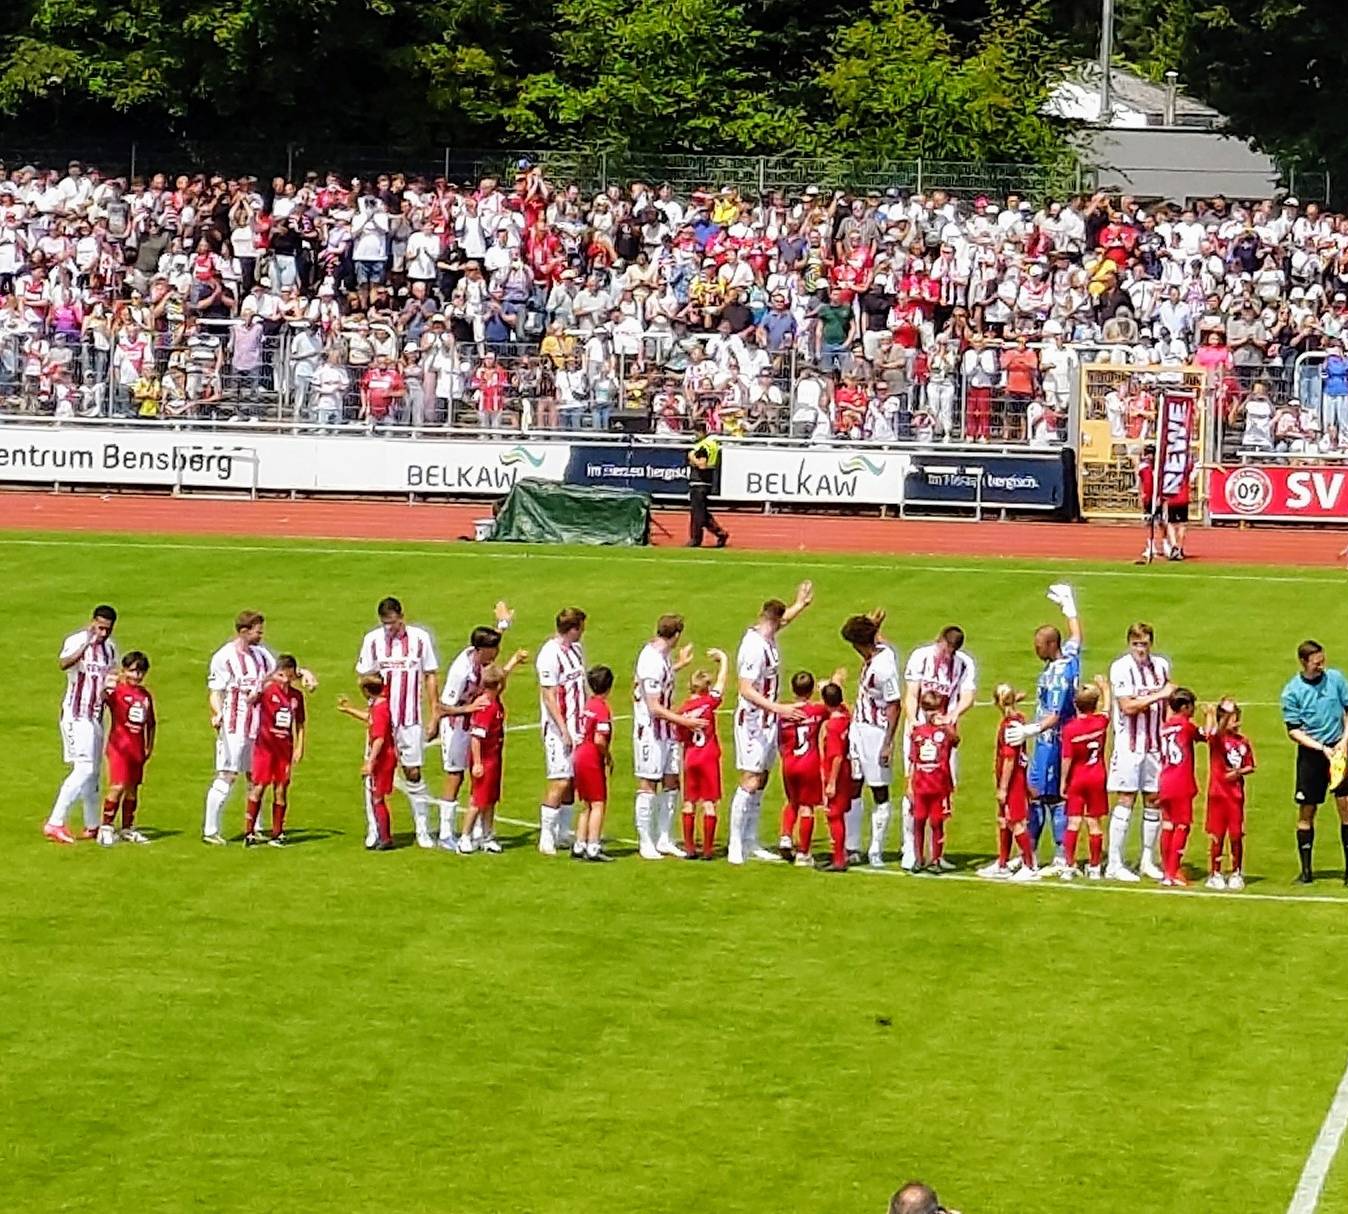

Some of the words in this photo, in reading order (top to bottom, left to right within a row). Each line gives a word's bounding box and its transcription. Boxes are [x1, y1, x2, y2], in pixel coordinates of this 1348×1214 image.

[102, 443, 233, 480] Bensberg
[407, 464, 517, 488] BELKAW
[746, 463, 858, 497] BELKAW
[1237, 482, 1260, 500] 09
[1286, 471, 1345, 509] SV
